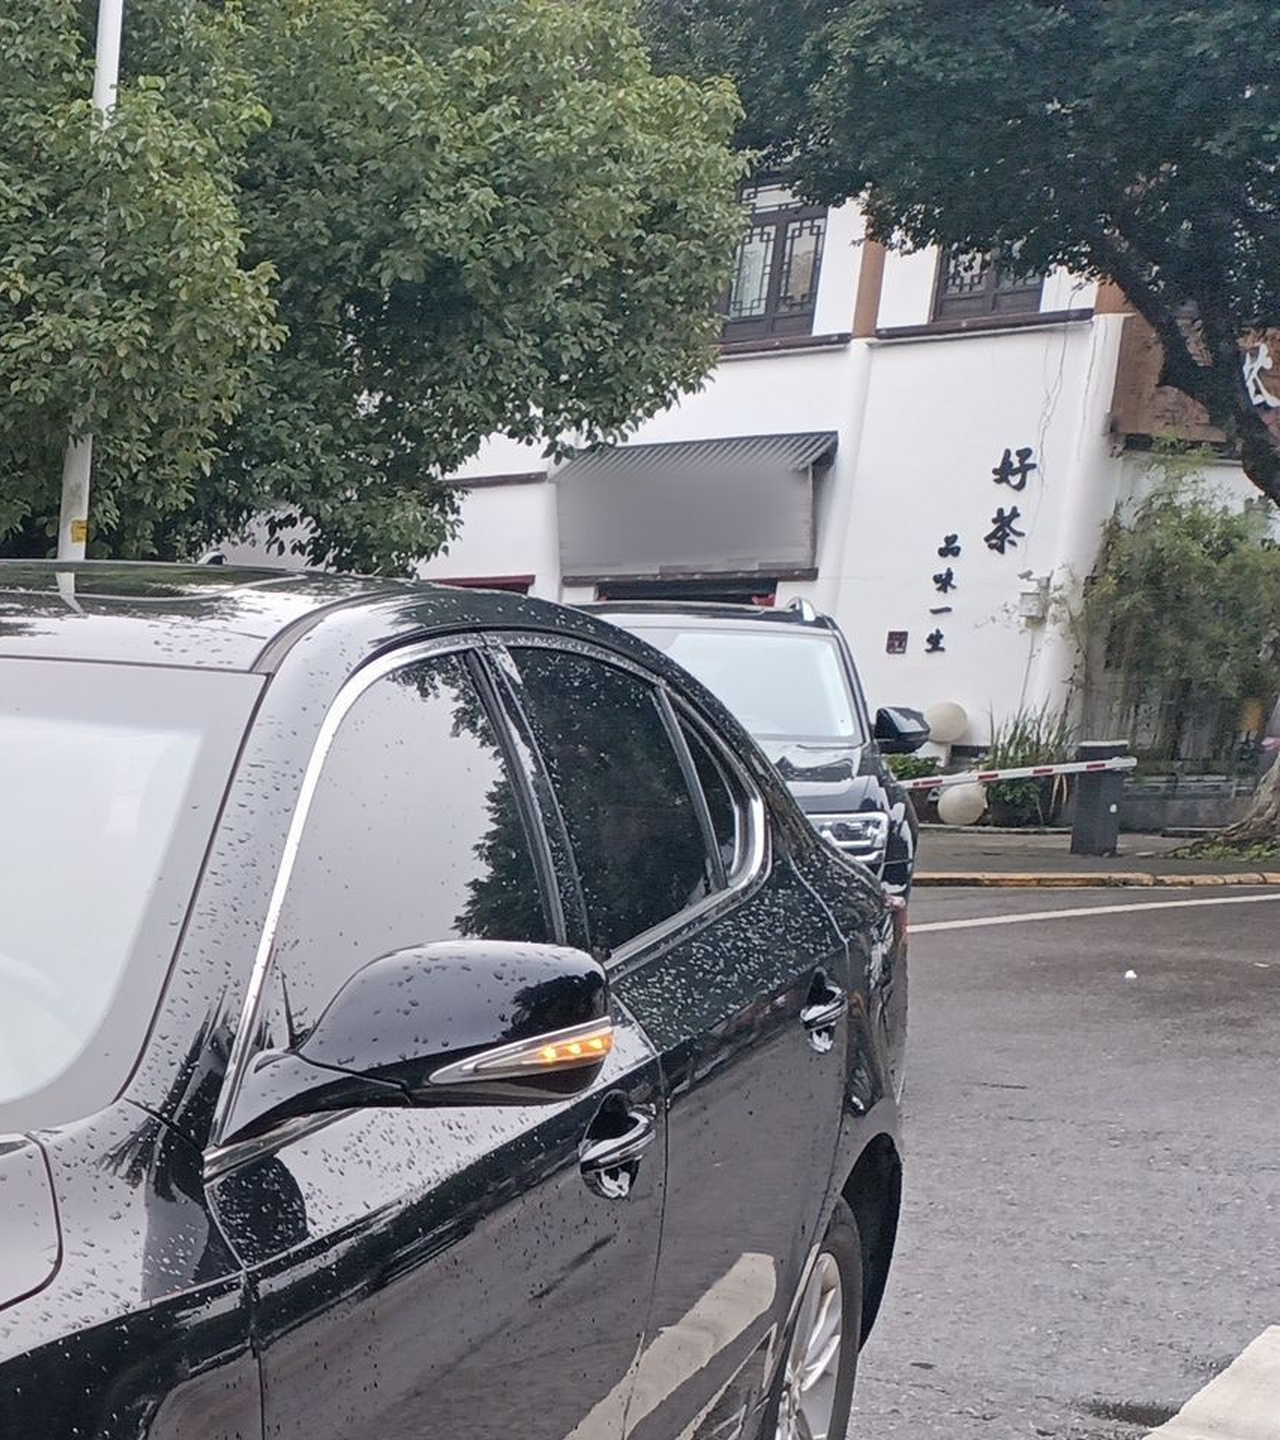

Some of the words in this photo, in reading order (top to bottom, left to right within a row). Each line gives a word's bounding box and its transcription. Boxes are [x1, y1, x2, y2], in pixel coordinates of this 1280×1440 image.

[984, 447, 1038, 554] 好茶
[924, 533, 961, 653] 品味一生
